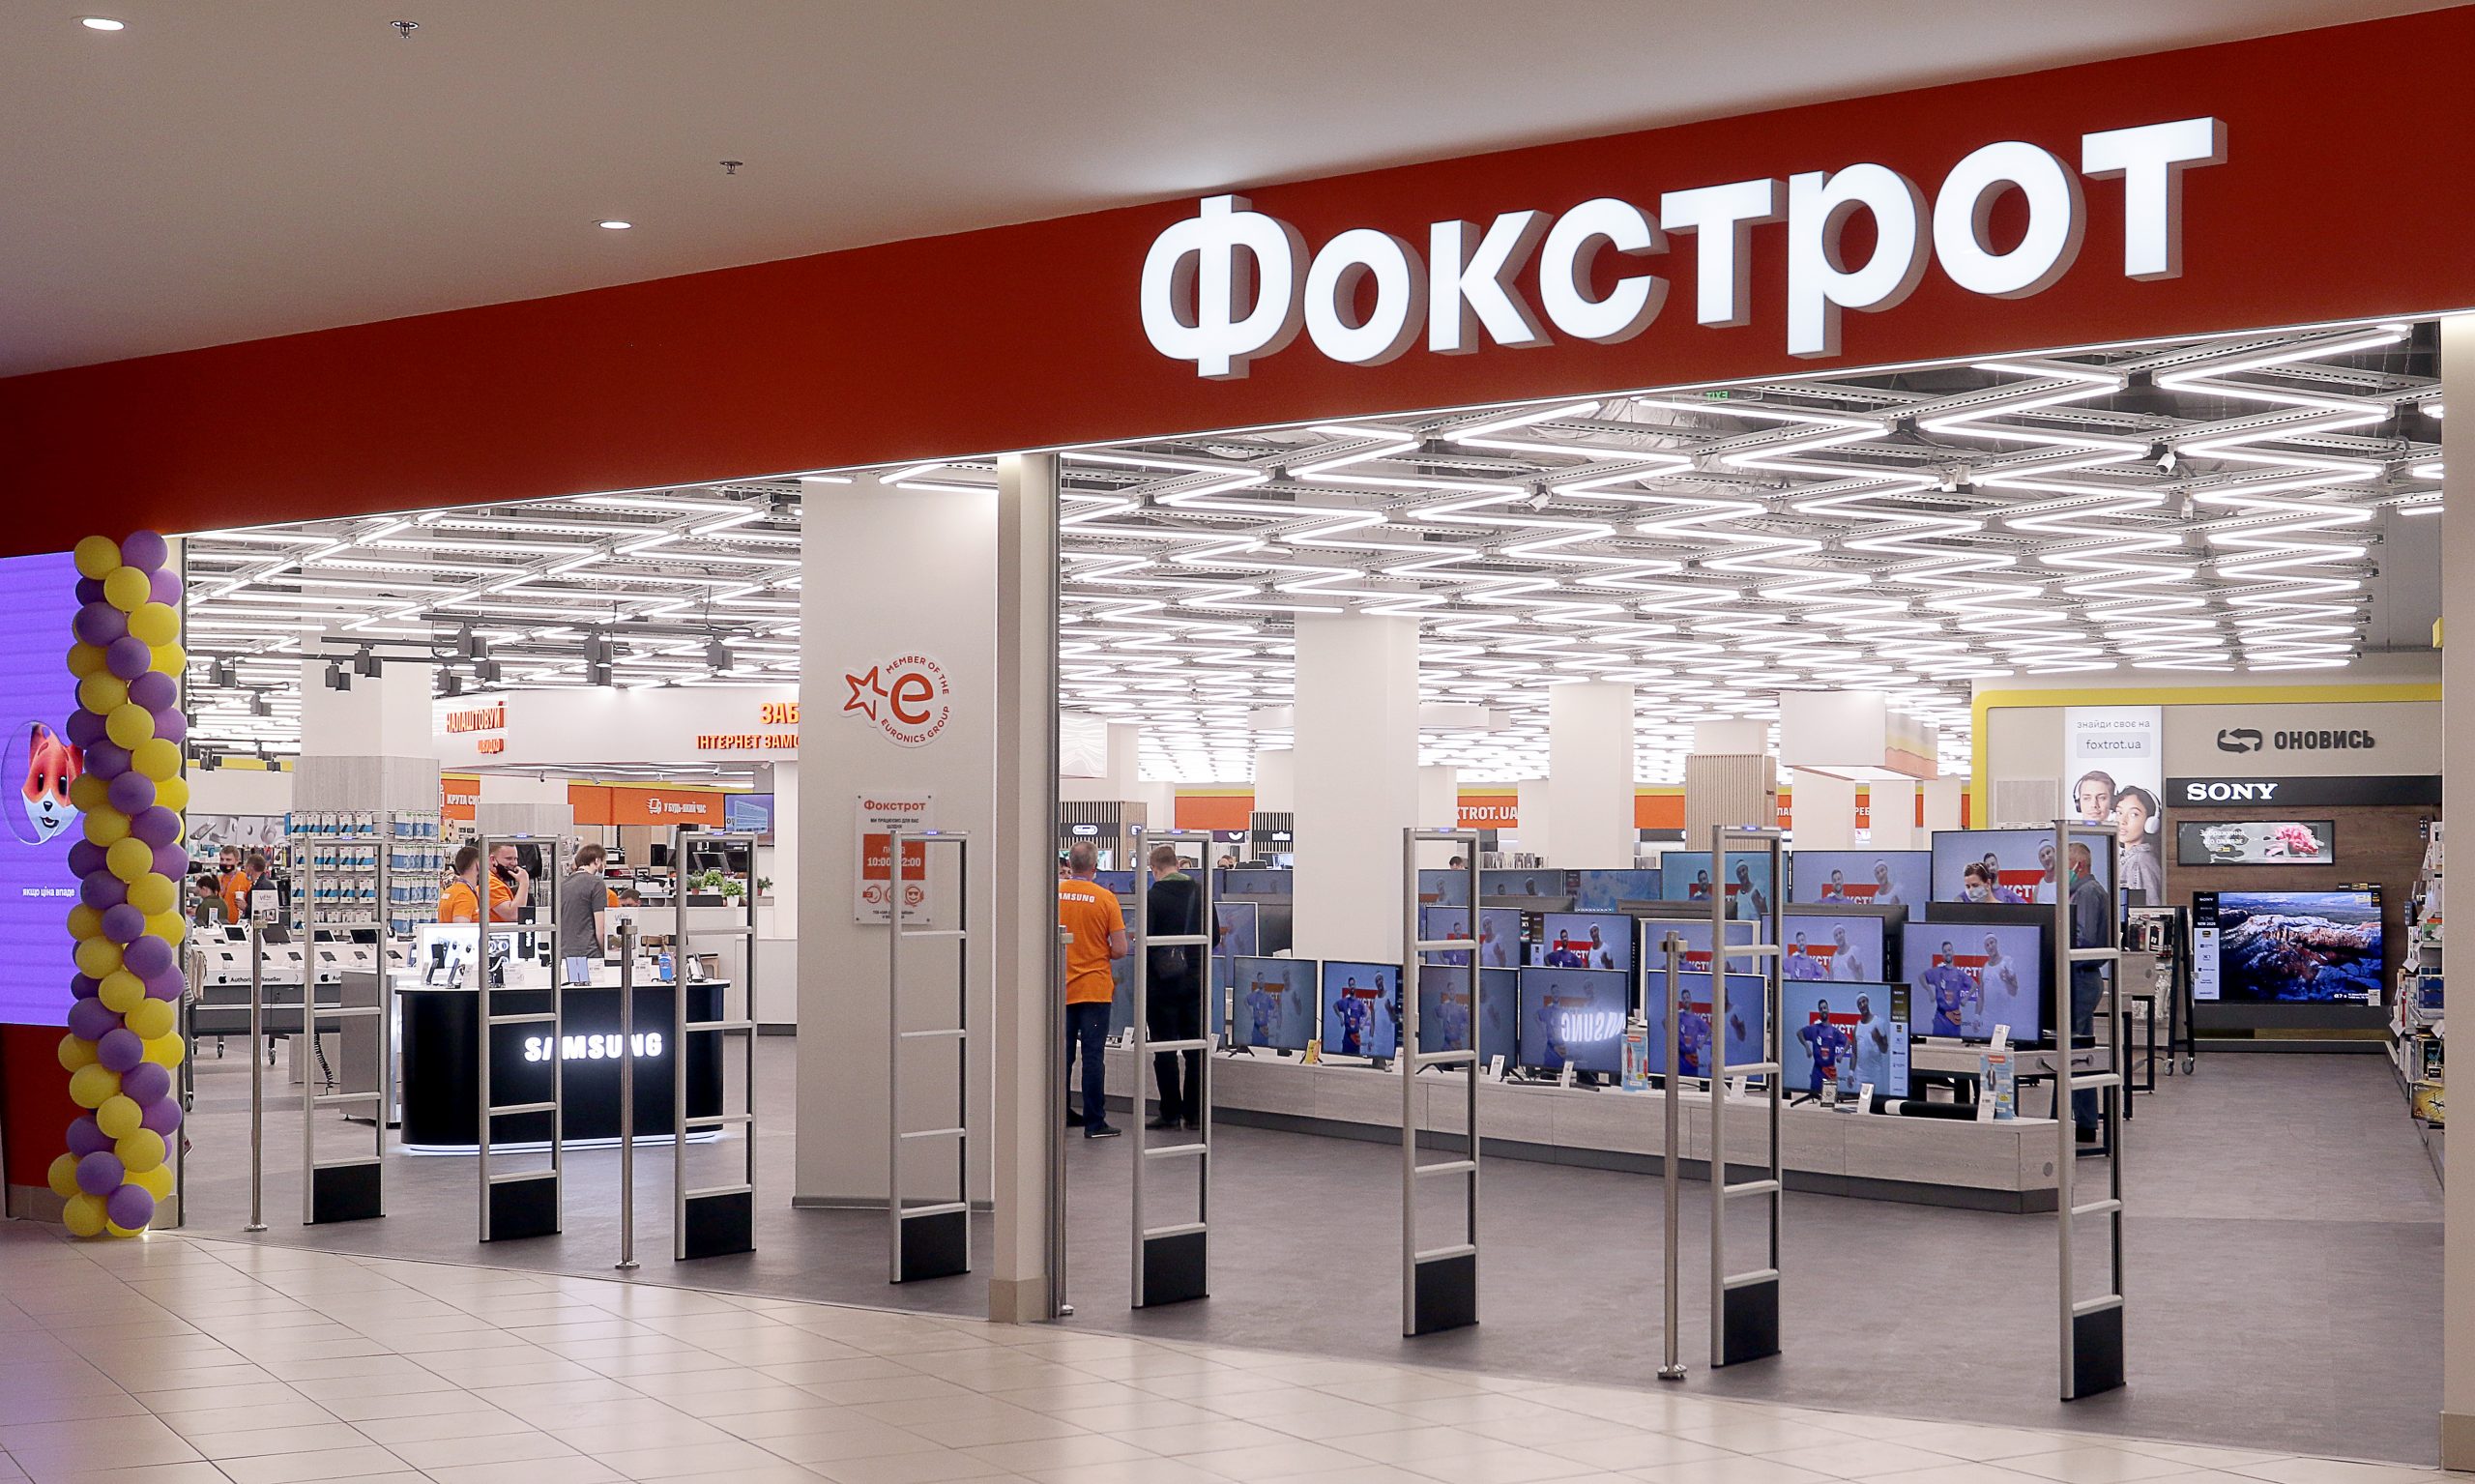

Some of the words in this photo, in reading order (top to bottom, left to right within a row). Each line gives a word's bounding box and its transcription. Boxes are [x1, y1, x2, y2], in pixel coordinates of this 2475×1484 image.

[1140, 115, 2228, 381] Фокстрот
[886, 655, 926, 674] MEMBER
[927, 661, 941, 674] OF
[938, 673, 949, 695] THE
[881, 718, 926, 743] EURONICS
[927, 706, 950, 738] GROUP
[2077, 720, 2111, 729] знайди
[695, 735, 761, 749] ІНТЕРНЕТ
[2085, 739, 2142, 750] foxtrot.ua
[2274, 730, 2376, 750] ОНОВИСЬ
[2186, 782, 2279, 800] SONY
[863, 800, 926, 812] Фокстрот
